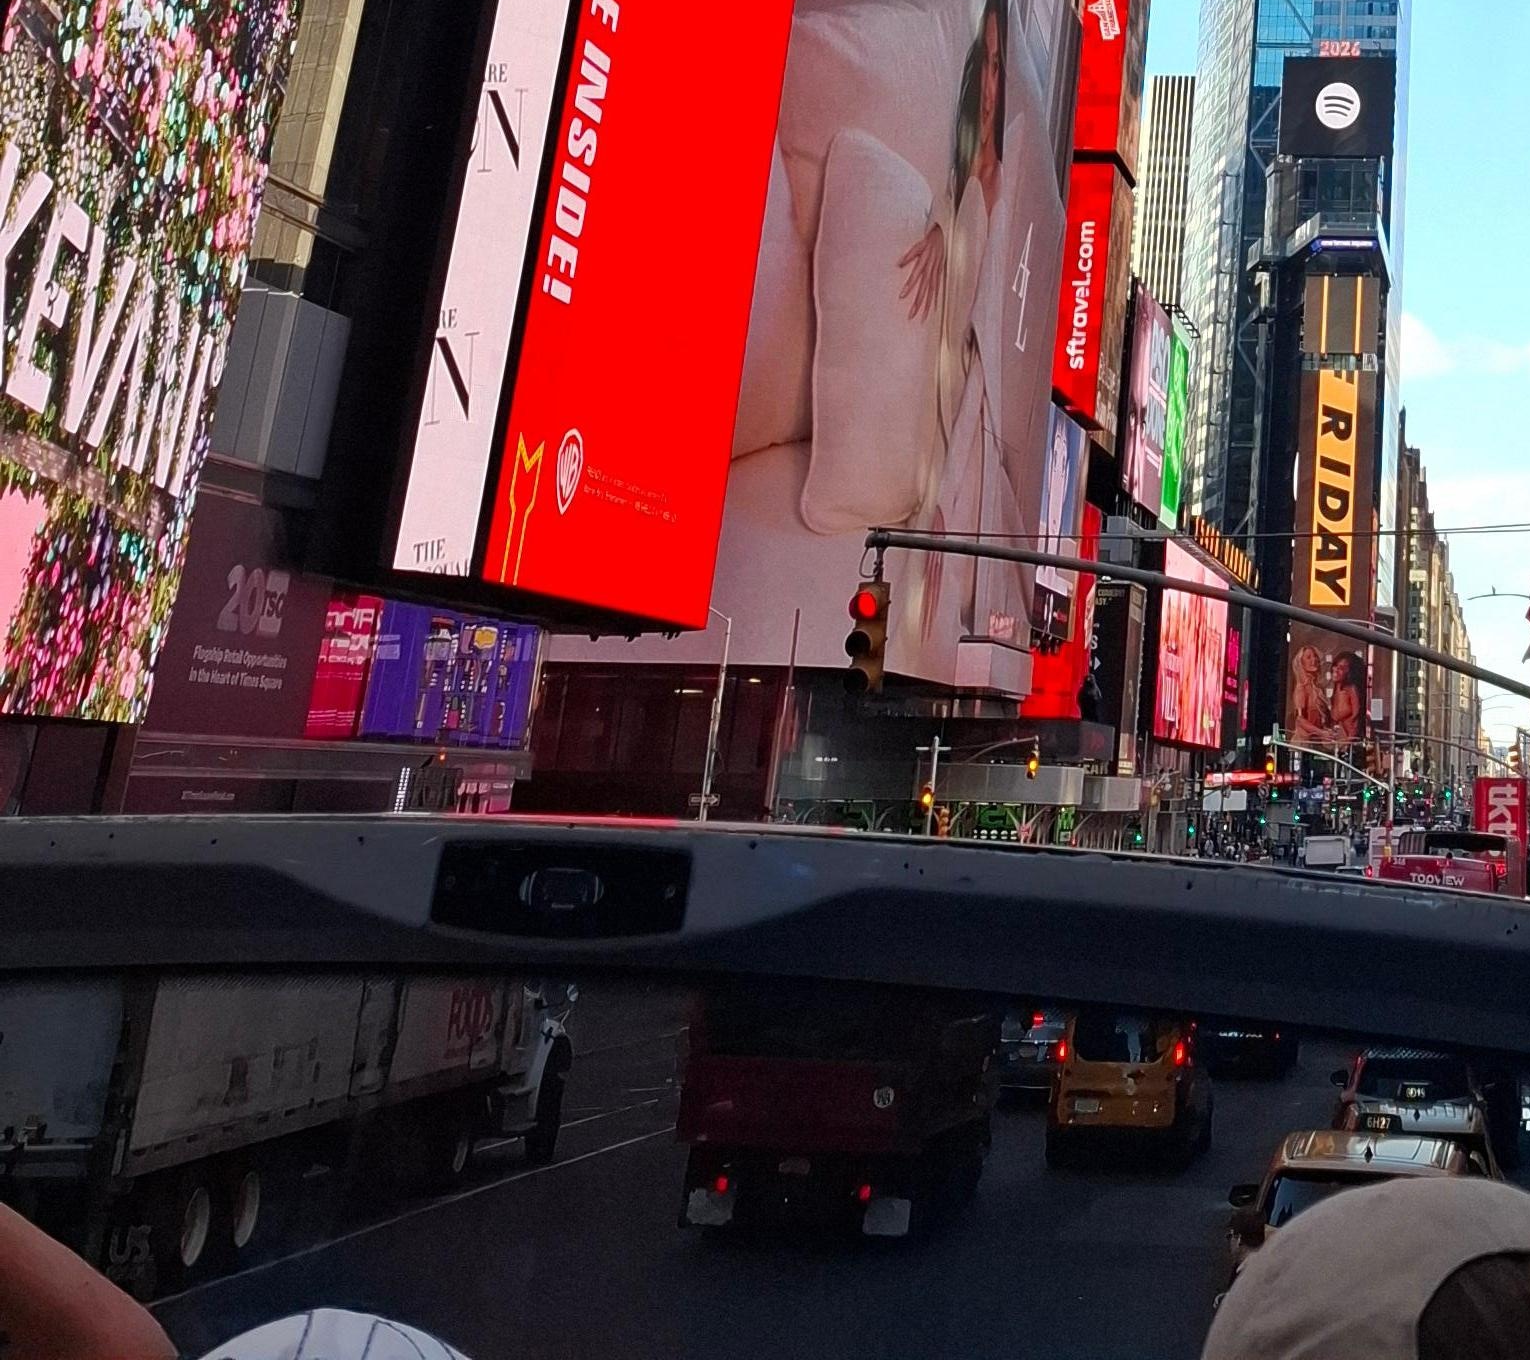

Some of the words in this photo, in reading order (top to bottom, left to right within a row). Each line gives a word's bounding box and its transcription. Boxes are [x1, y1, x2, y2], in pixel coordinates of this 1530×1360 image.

[1319, 40, 1361, 57] 2026
[542, 39, 612, 305] INSIDE!
[1069, 220, 1096, 371] sftravel.com
[1366, 1116, 1392, 1130] 6H27
